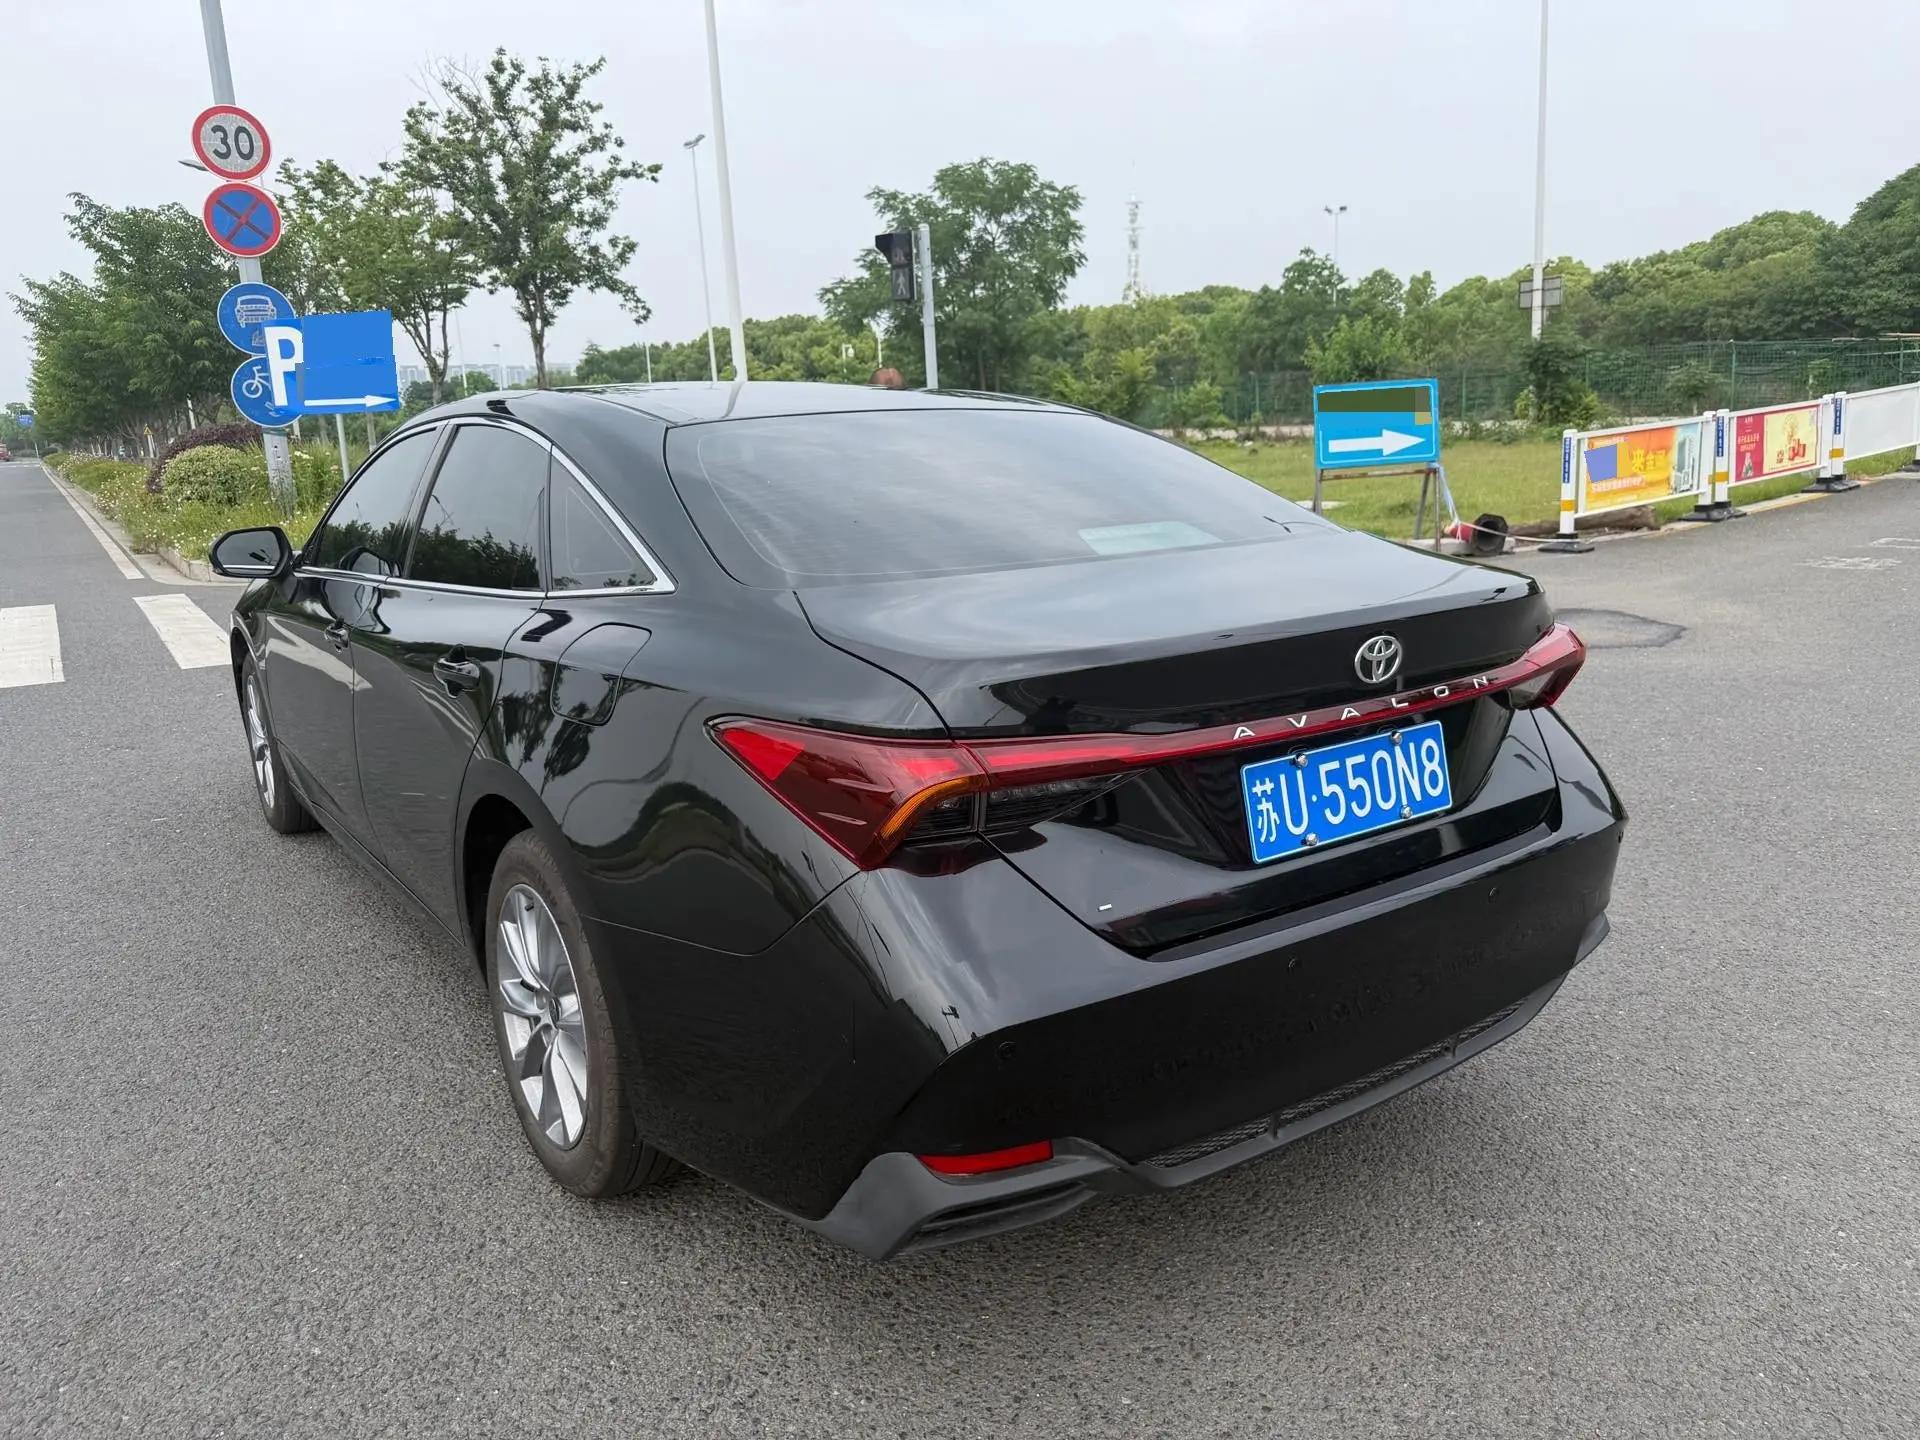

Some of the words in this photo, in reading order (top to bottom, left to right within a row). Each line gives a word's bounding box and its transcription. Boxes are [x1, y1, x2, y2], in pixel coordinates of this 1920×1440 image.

[211, 125, 254, 161] 30
[263, 325, 304, 407] P
[1232, 675, 1489, 741] AVALON
